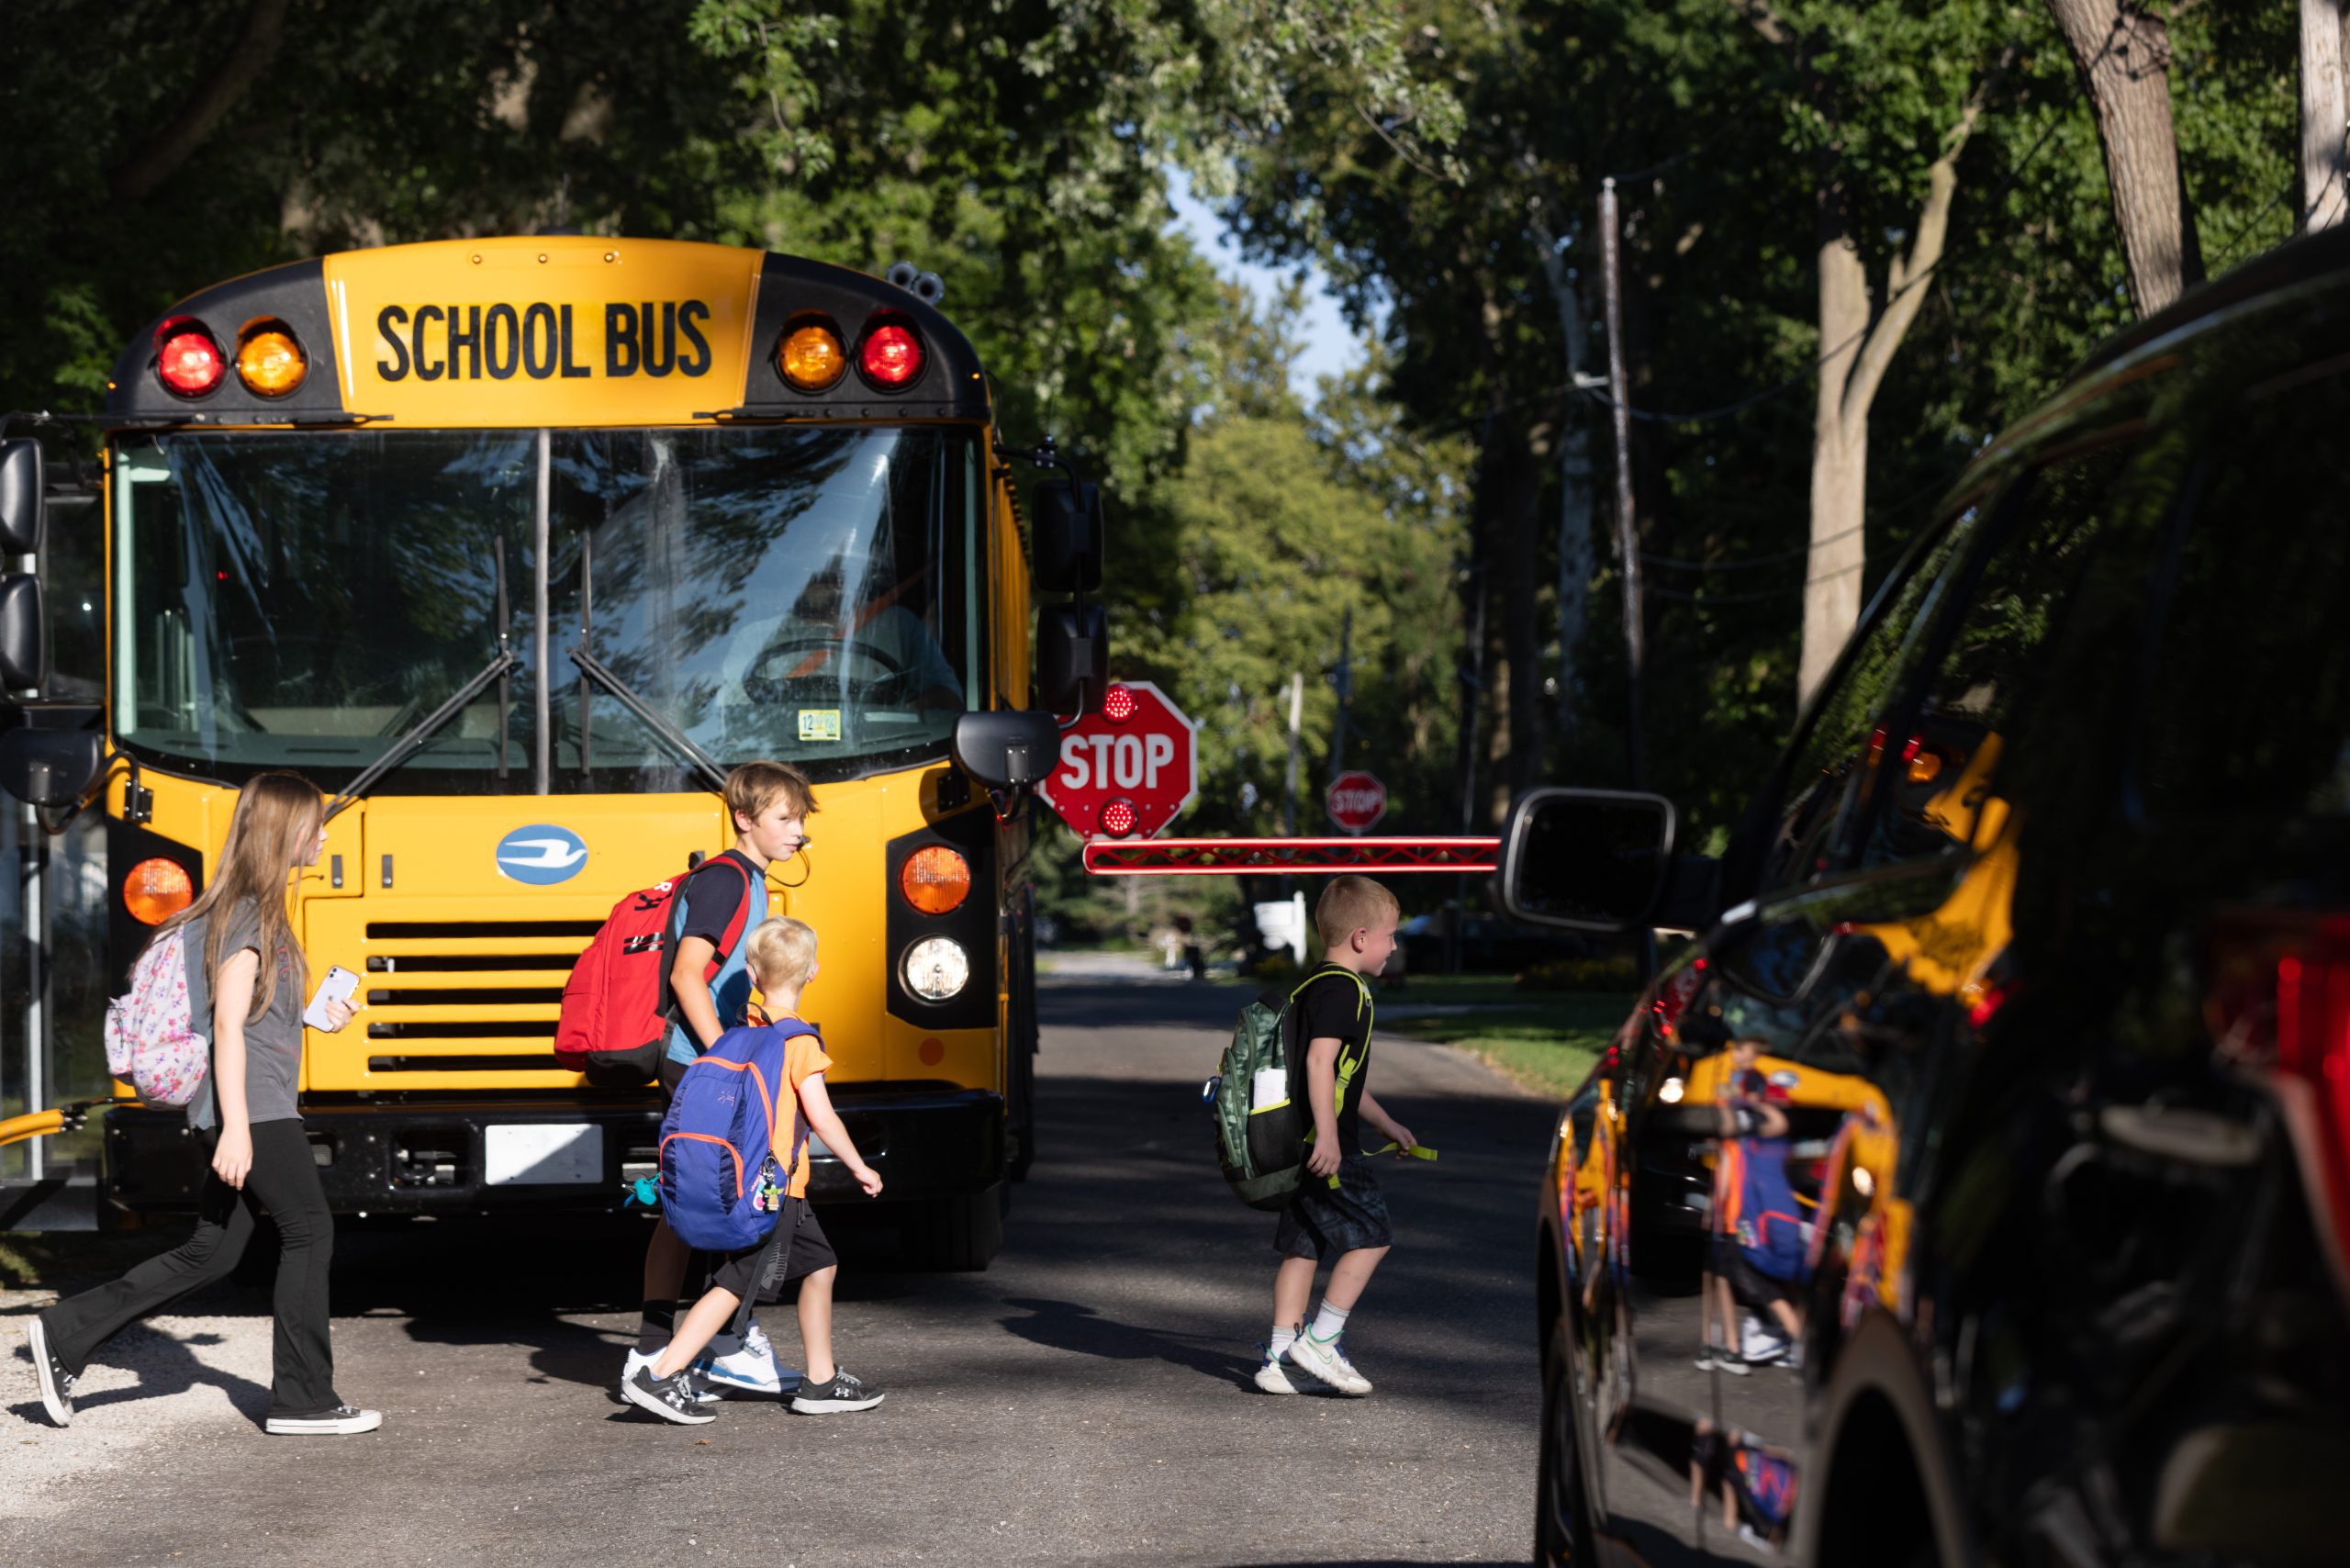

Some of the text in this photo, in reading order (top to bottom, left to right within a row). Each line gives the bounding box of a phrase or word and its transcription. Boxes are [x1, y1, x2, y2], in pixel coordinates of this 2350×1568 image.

[377, 299, 712, 382] SCHOOL BUS
[1060, 734, 1174, 790] STOP
[1332, 790, 1379, 813] STOP
